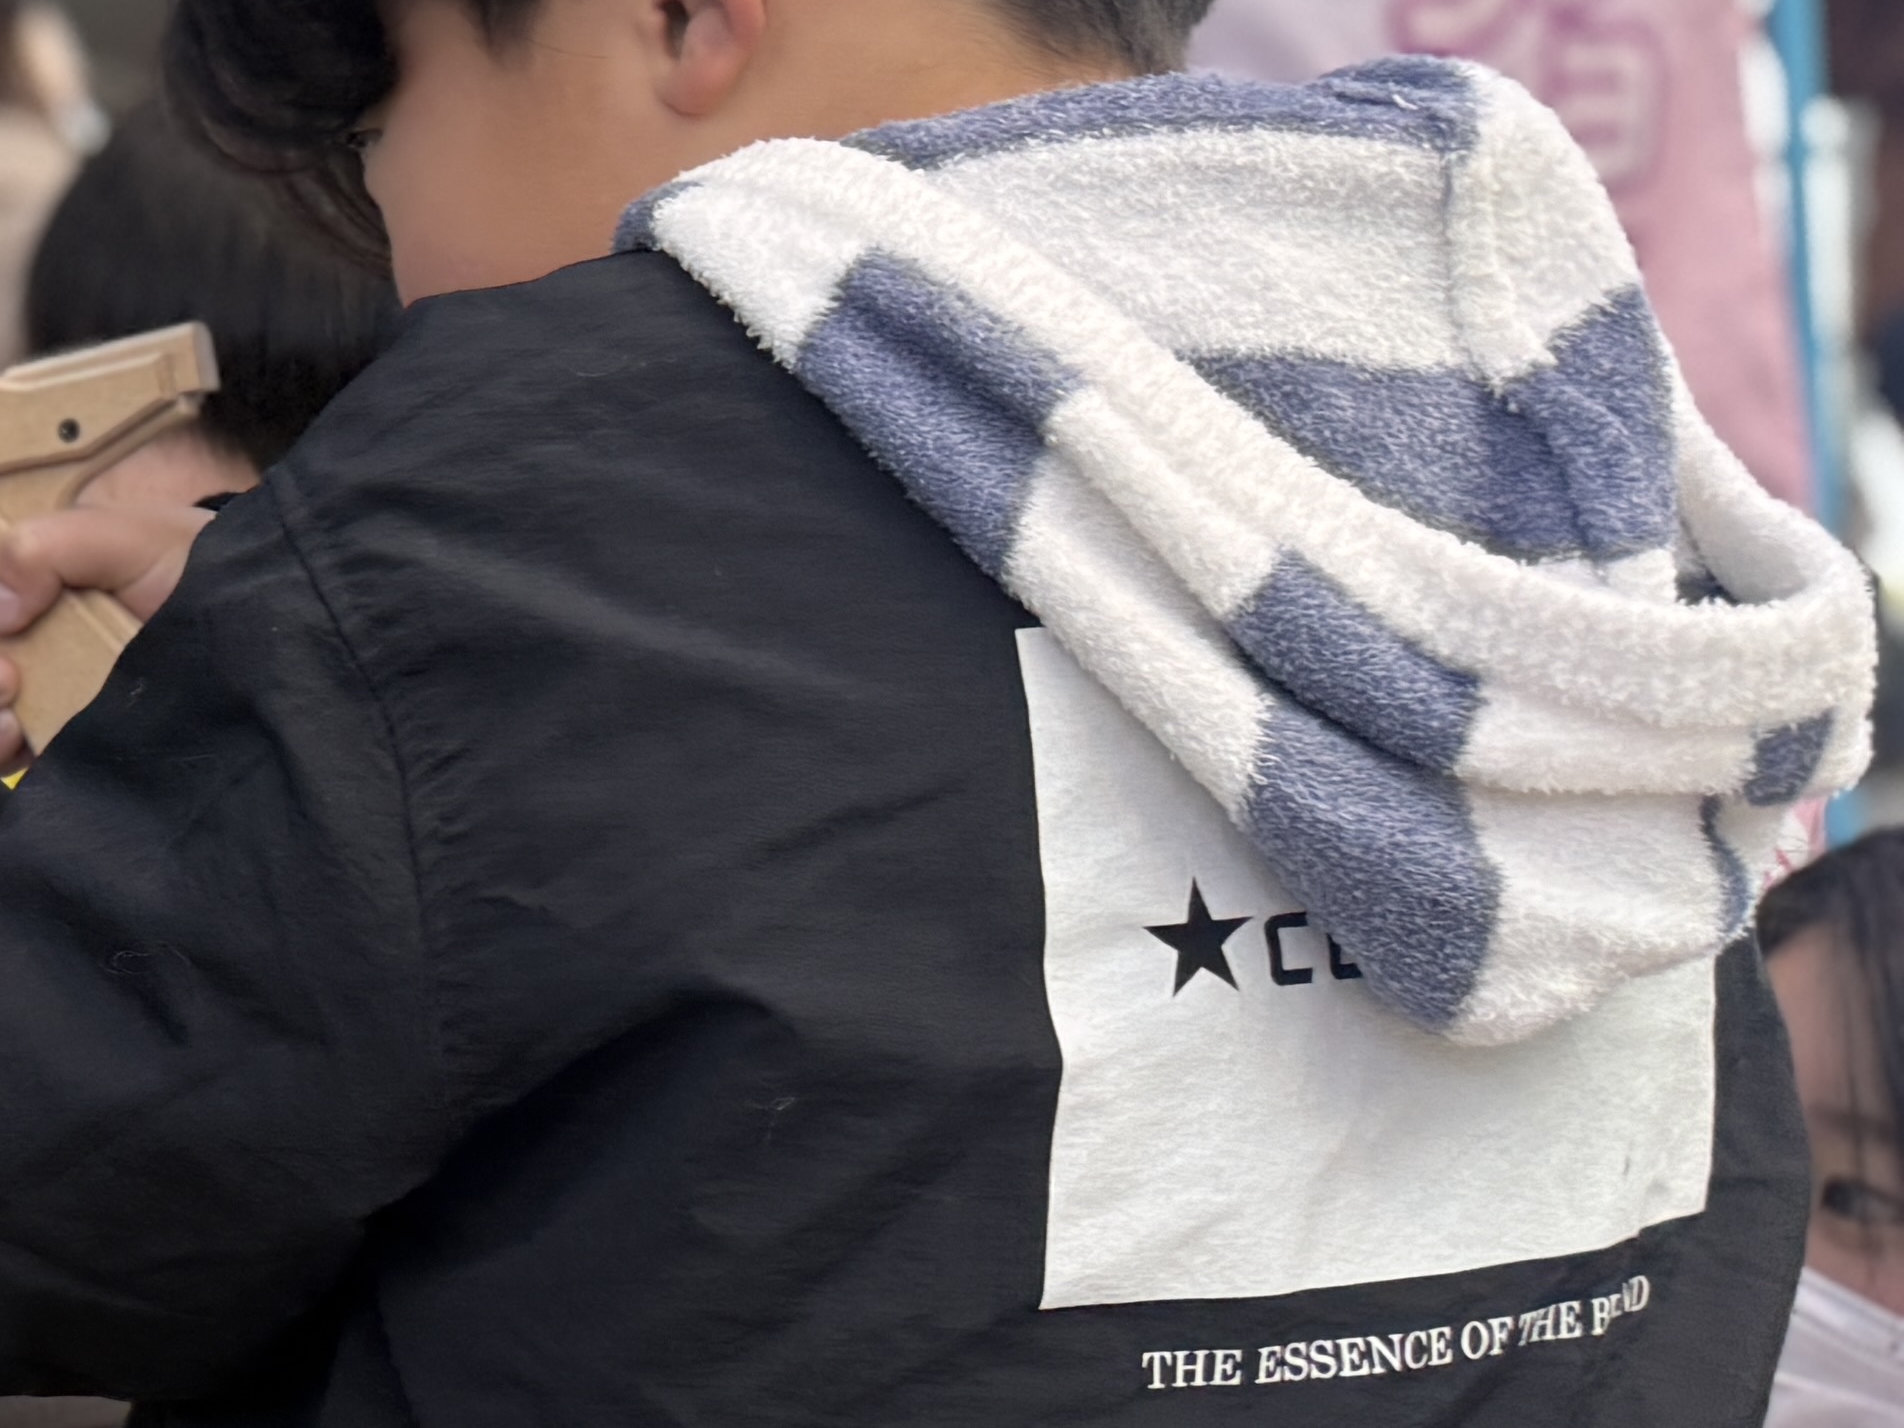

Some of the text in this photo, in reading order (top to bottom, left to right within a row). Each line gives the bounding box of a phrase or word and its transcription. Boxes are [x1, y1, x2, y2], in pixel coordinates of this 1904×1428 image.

[1141, 1349, 1243, 1389] THE
[1255, 1326, 1453, 1384] ESSENCE
[1460, 1316, 1514, 1360] OF
[1517, 1300, 1583, 1347] THE
